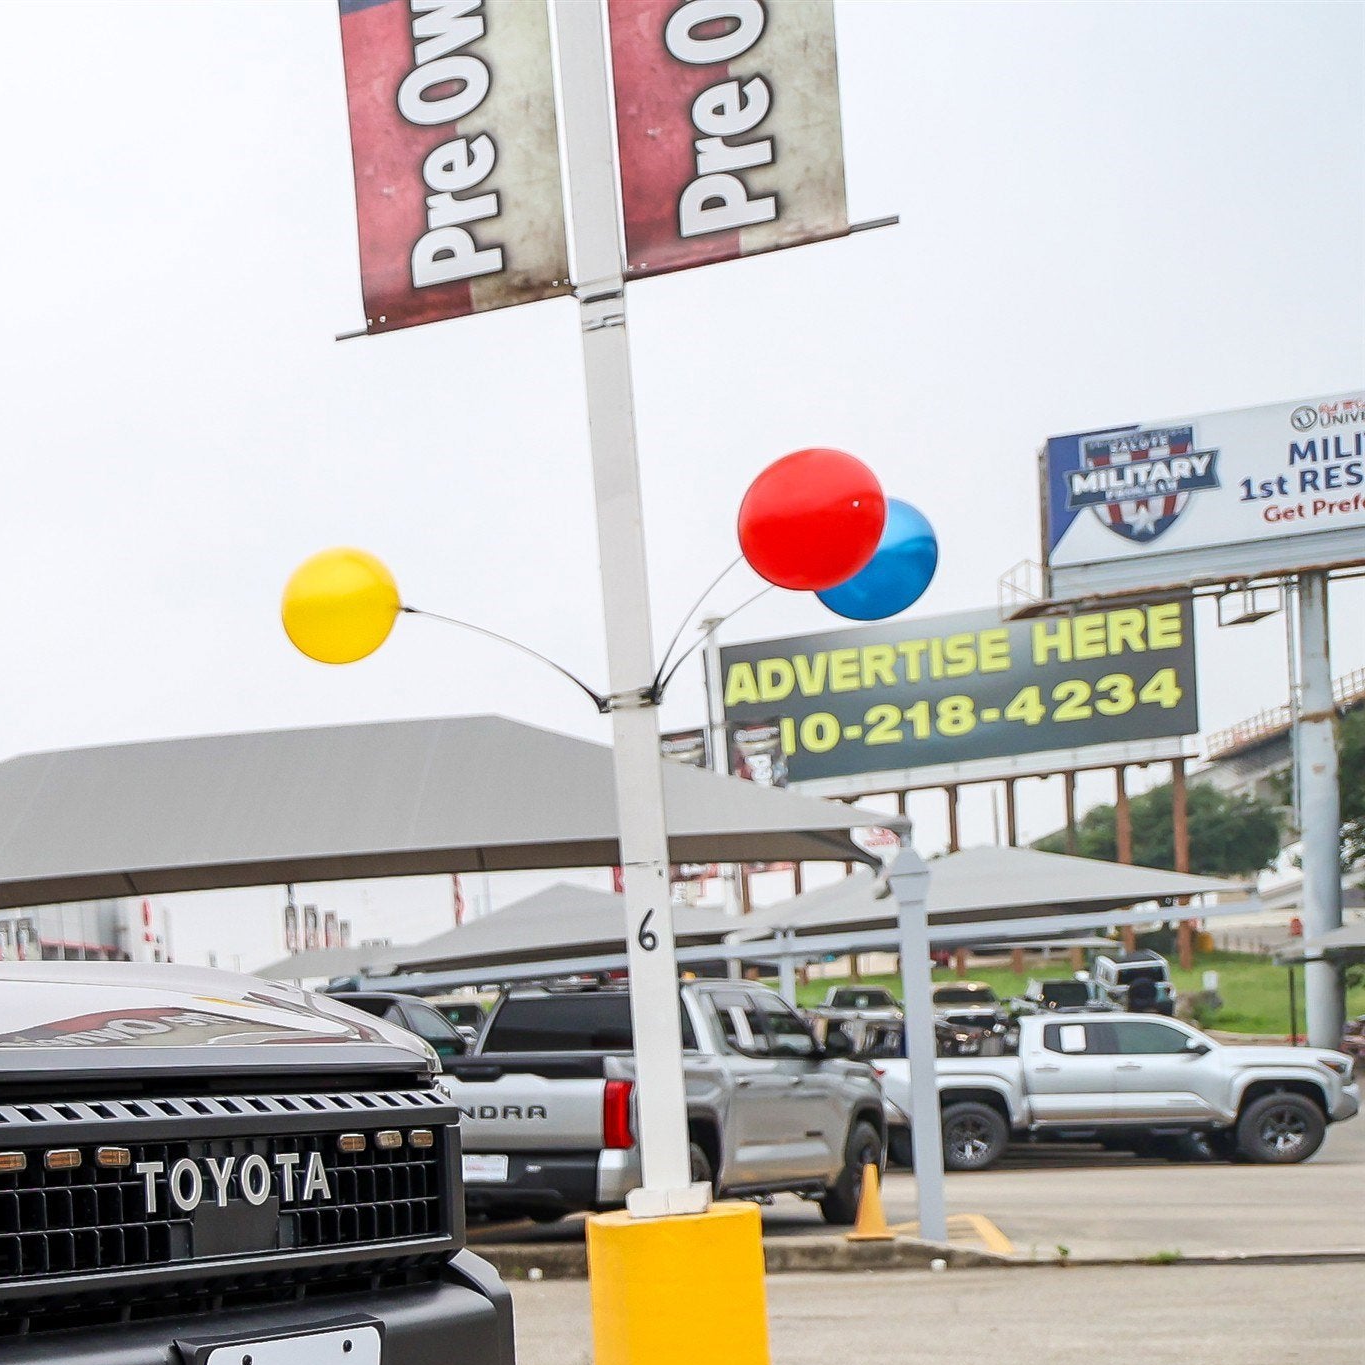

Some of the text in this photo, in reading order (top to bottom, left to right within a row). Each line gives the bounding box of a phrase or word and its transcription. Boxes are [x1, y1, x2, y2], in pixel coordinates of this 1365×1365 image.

[679, 77, 777, 238] Pre
[410, 133, 504, 289] Pre
[1288, 433, 1365, 466] MILI
[1071, 453, 1213, 496] MILITARY
[1239, 475, 1289, 501] 1st
[1263, 503, 1305, 522] Get
[724, 602, 1183, 707] ADVERTISE HERE
[638, 908, 659, 952] 6
[135, 1151, 332, 1214] TOYOTA
